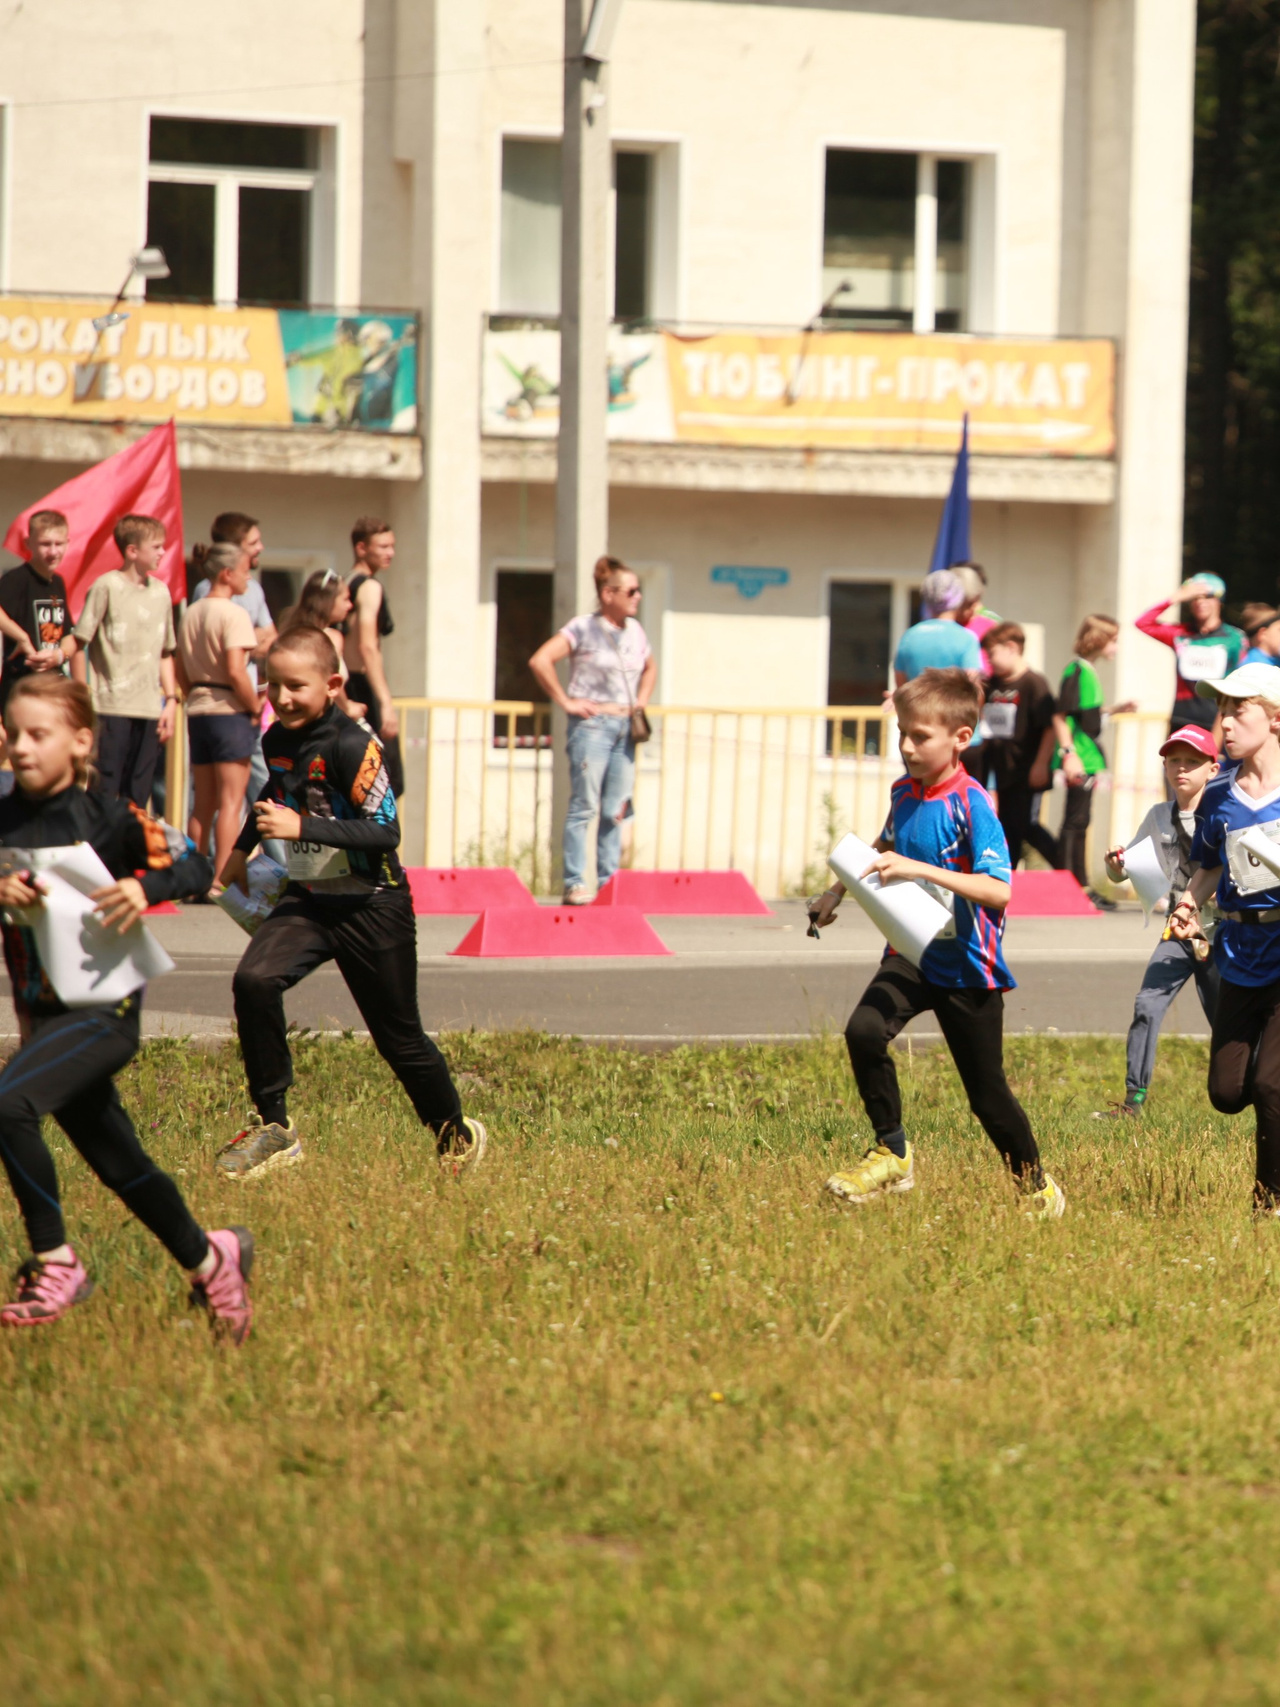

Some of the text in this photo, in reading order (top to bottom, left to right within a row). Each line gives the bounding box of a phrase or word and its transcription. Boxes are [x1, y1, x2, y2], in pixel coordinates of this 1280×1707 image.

[137, 321, 250, 362] ЛЫЖ
[0, 358, 267, 409] НОУБОРДОВ
[682, 351, 1091, 409] ТЮБИНГ-ПРОКАТ
